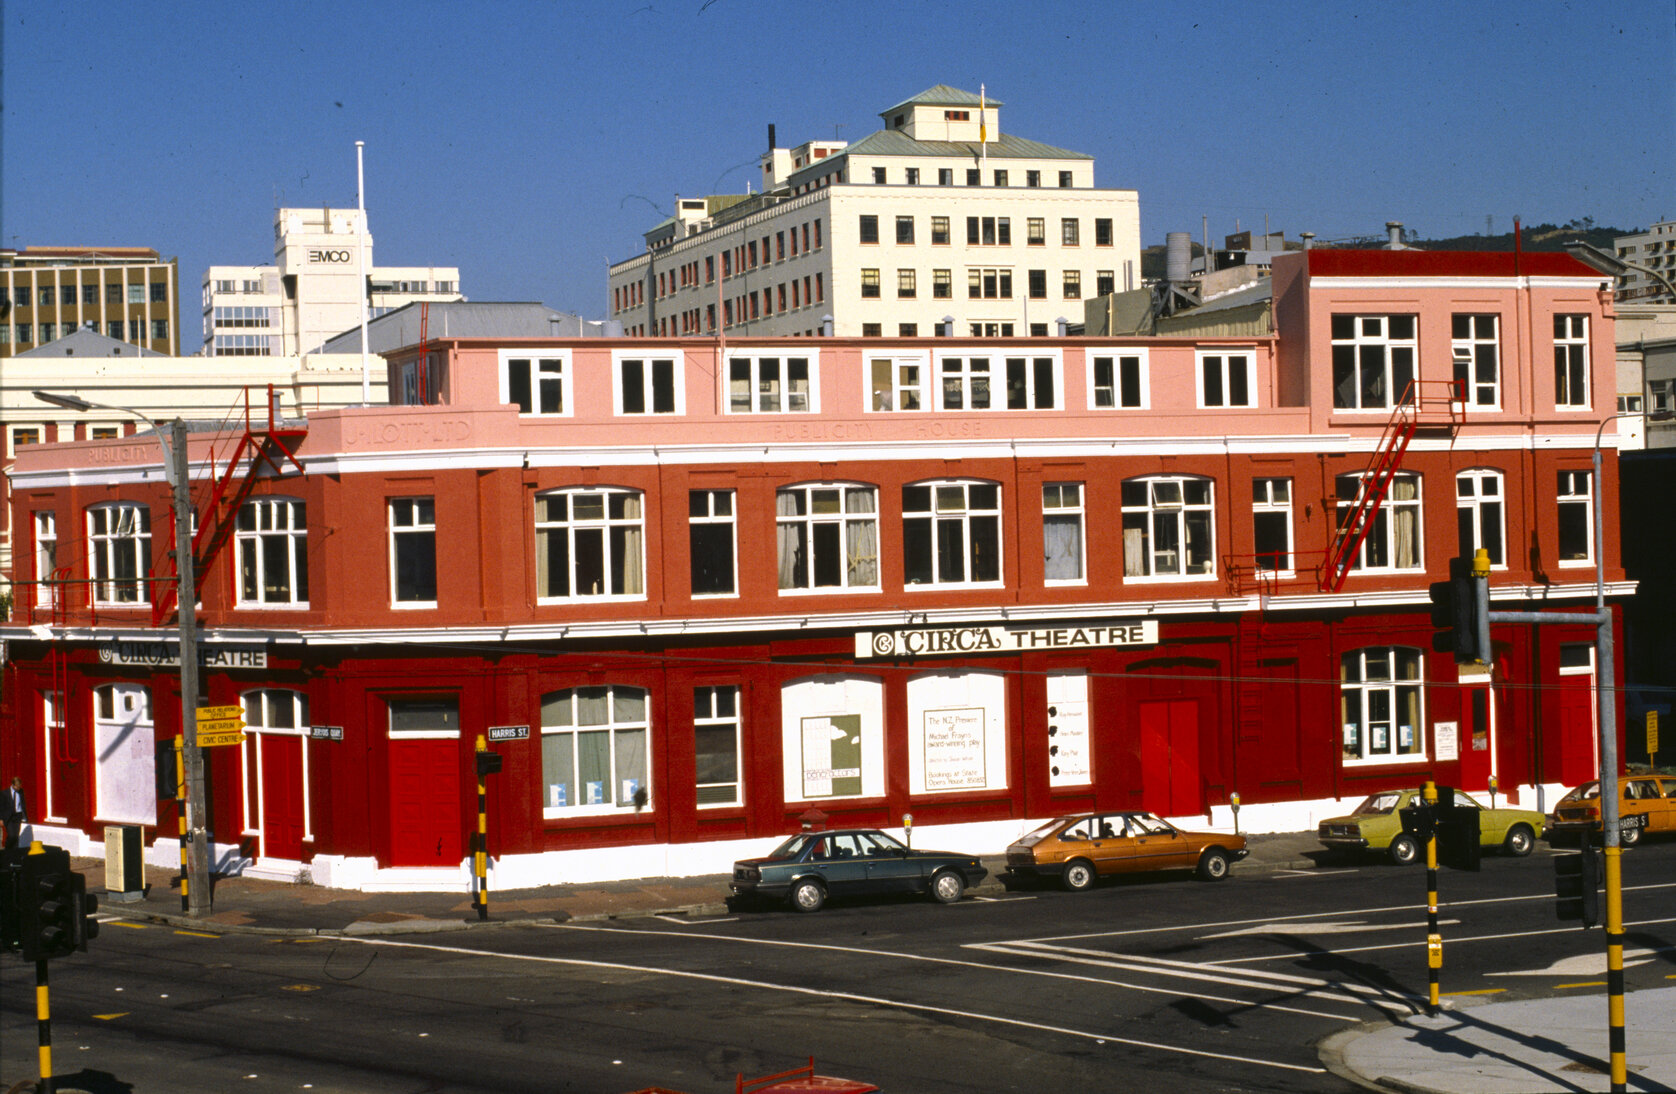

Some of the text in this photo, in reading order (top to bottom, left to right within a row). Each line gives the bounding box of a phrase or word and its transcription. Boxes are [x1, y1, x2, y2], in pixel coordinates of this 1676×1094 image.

[309, 250, 350, 262] EMCO
[772, 421, 982, 439] PUBLICITY HOUSE
[88, 446, 148, 464] PUBLICITY
[900, 626, 1144, 653] CIRCA THEATRE
[117, 642, 264, 667] CIRCA EATRE
[202, 722, 235, 730] PLANETARIUM
[203, 734, 238, 745] CIVIC CENTRE
[492, 728, 516, 739] HARRIS
[1620, 816, 1639, 829] HARRIS
